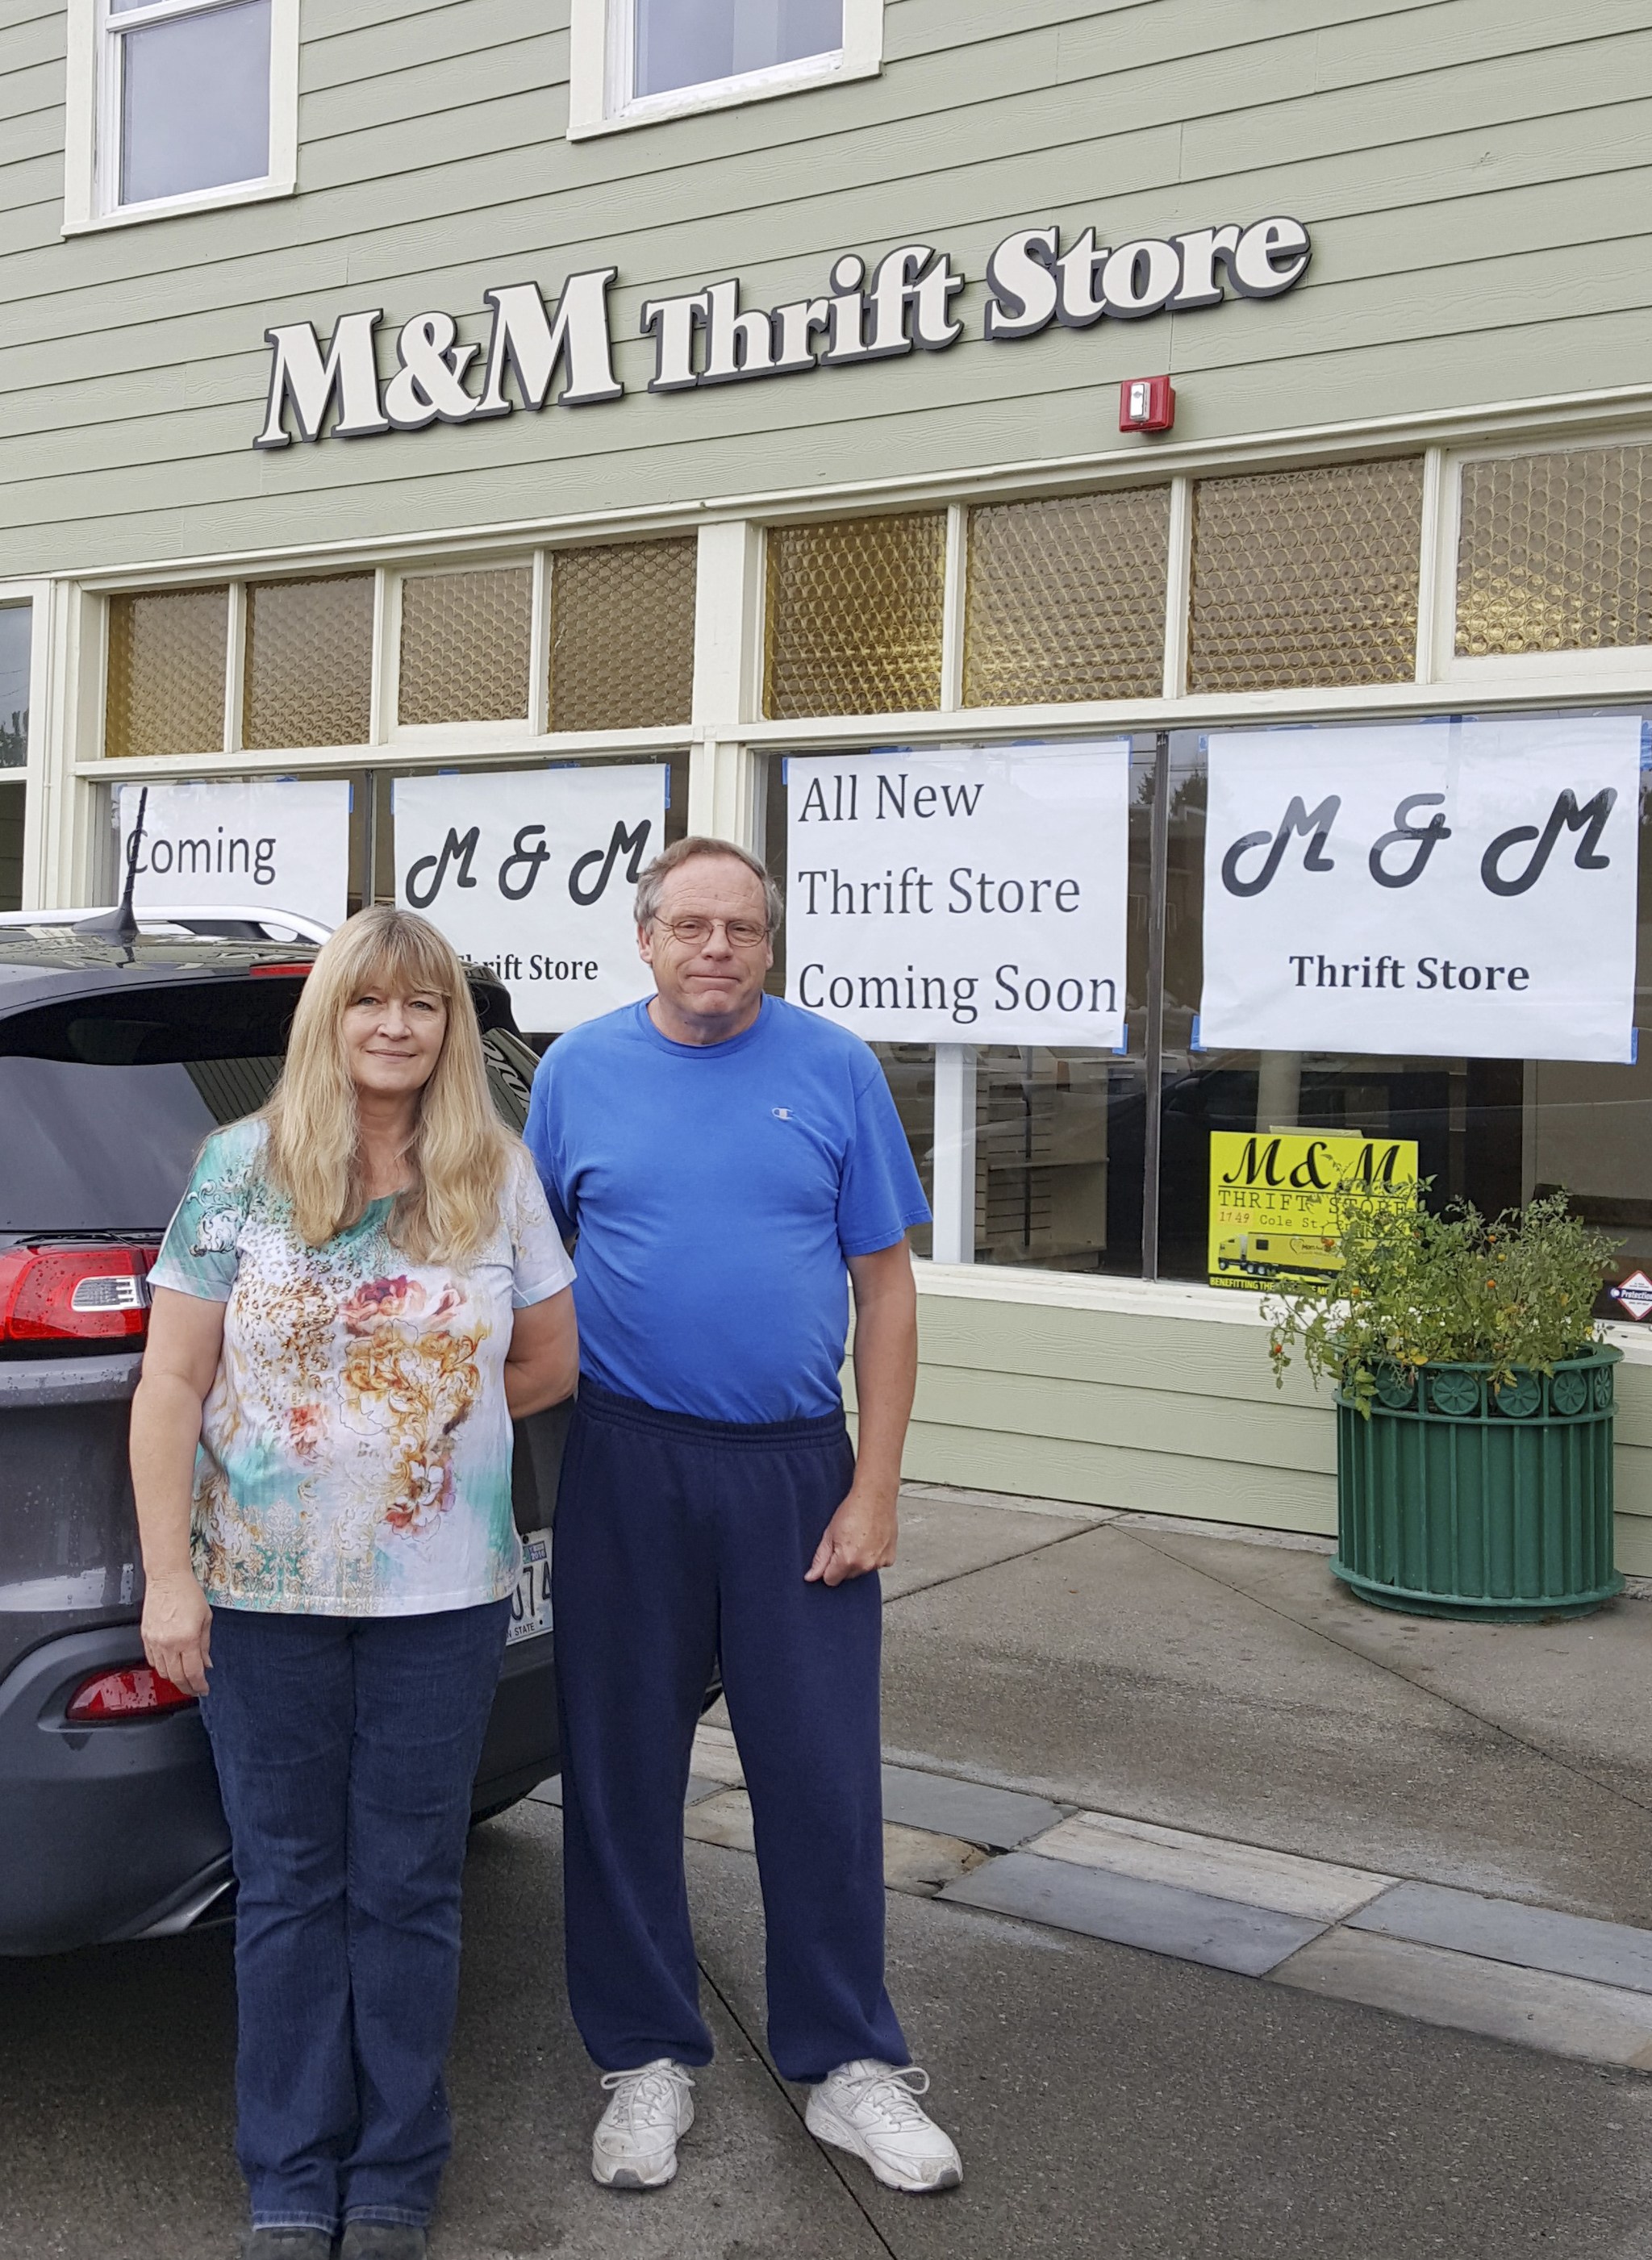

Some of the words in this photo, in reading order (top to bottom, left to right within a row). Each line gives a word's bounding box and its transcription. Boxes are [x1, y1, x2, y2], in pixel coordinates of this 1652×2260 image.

[253, 265, 624, 449] M&M
[640, 244, 965, 394] Thrift
[984, 215, 1312, 340] Store
[798, 774, 858, 821] All
[875, 773, 984, 819] New
[127, 826, 277, 886] Coming
[405, 826, 481, 909] M
[498, 824, 551, 901] &
[568, 819, 652, 906] M
[1221, 794, 1341, 898] M
[1368, 792, 1452, 889] &
[1480, 786, 1618, 897] M
[798, 866, 934, 915] Thrift
[948, 867, 1081, 914] Store
[529, 954, 599, 981] Store
[1289, 955, 1405, 990] Thrift
[1416, 957, 1530, 991] Store
[799, 963, 979, 1024] Coming
[995, 964, 1118, 1013] Soon
[1223, 1137, 1285, 1186] M
[1290, 1141, 1331, 1189] &
[1218, 1190, 1308, 1211] THRIFT
[1259, 1214, 1292, 1227] Cole
[1210, 1277, 1258, 1289] BENEFITTING
[1621, 1289, 1652, 1300] Protectio
[514, 1622, 535, 1636] STATE
